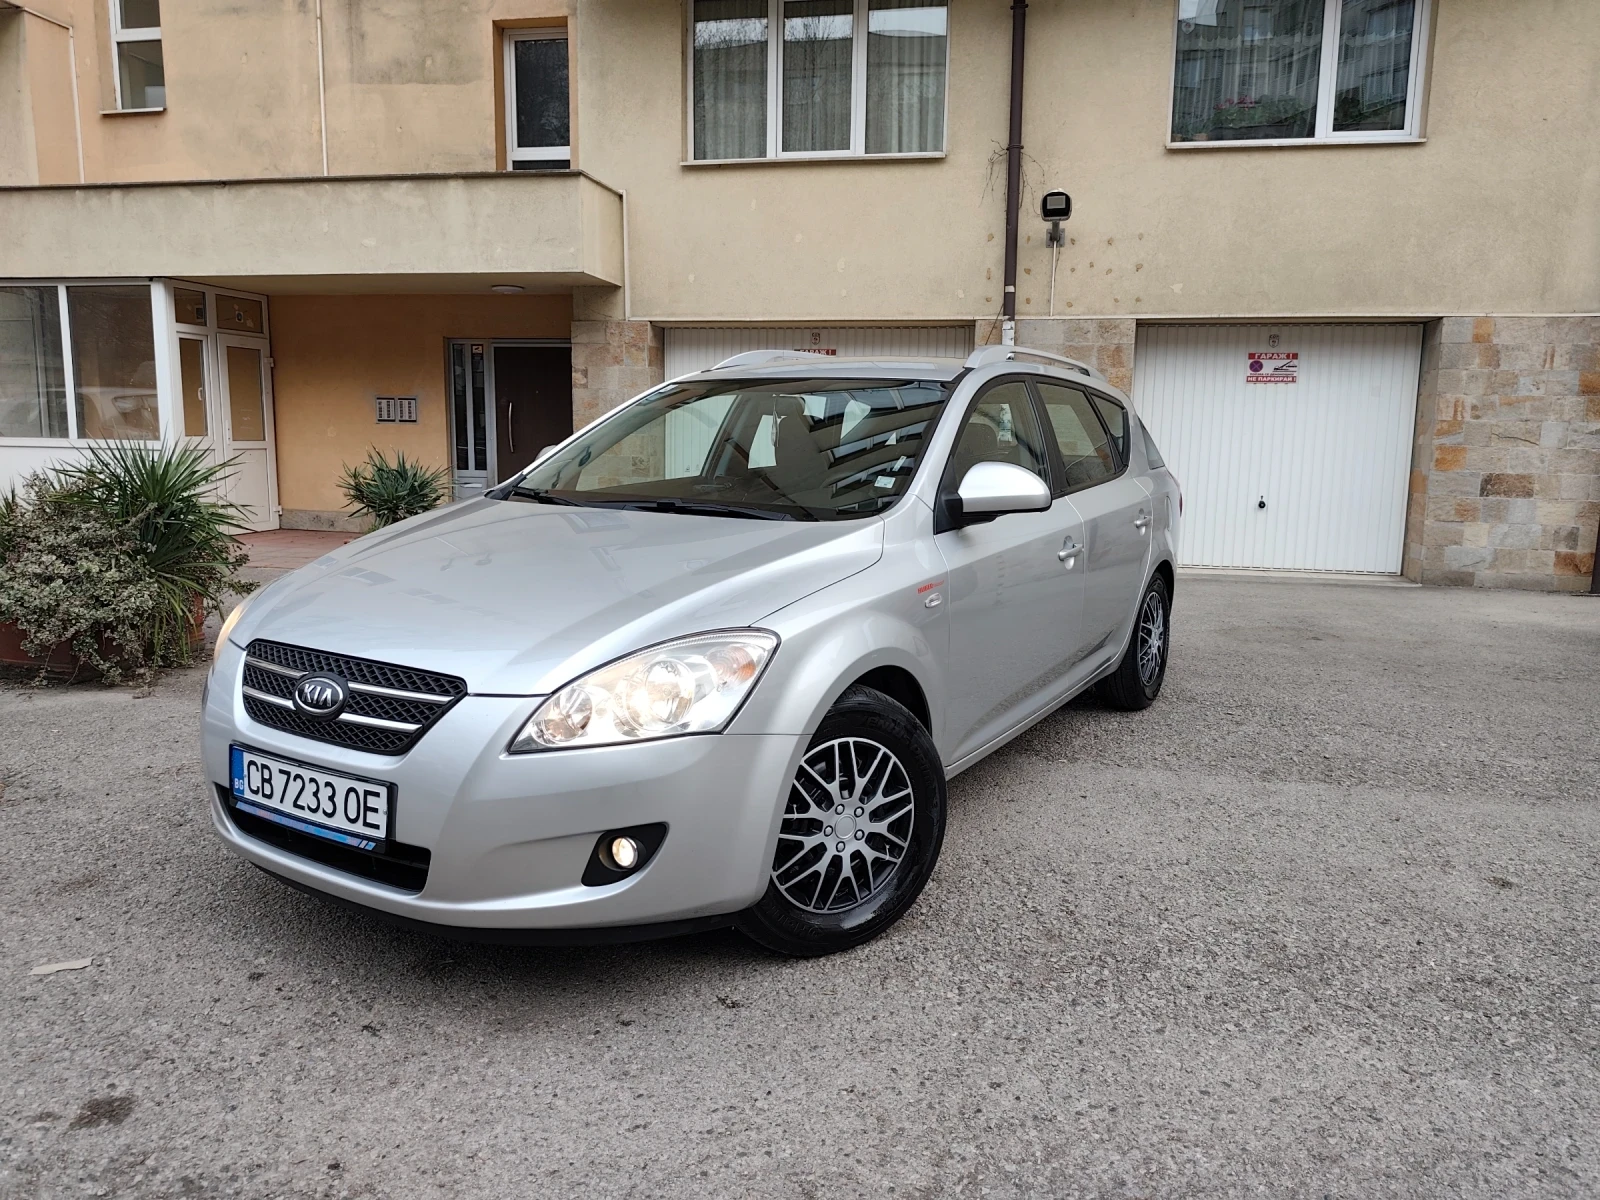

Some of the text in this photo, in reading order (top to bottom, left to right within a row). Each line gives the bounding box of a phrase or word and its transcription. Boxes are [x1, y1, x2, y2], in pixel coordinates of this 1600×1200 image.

[301, 683, 332, 707] KIA
[234, 777, 244, 791] BG
[246, 759, 381, 830] CB 7233 OE
